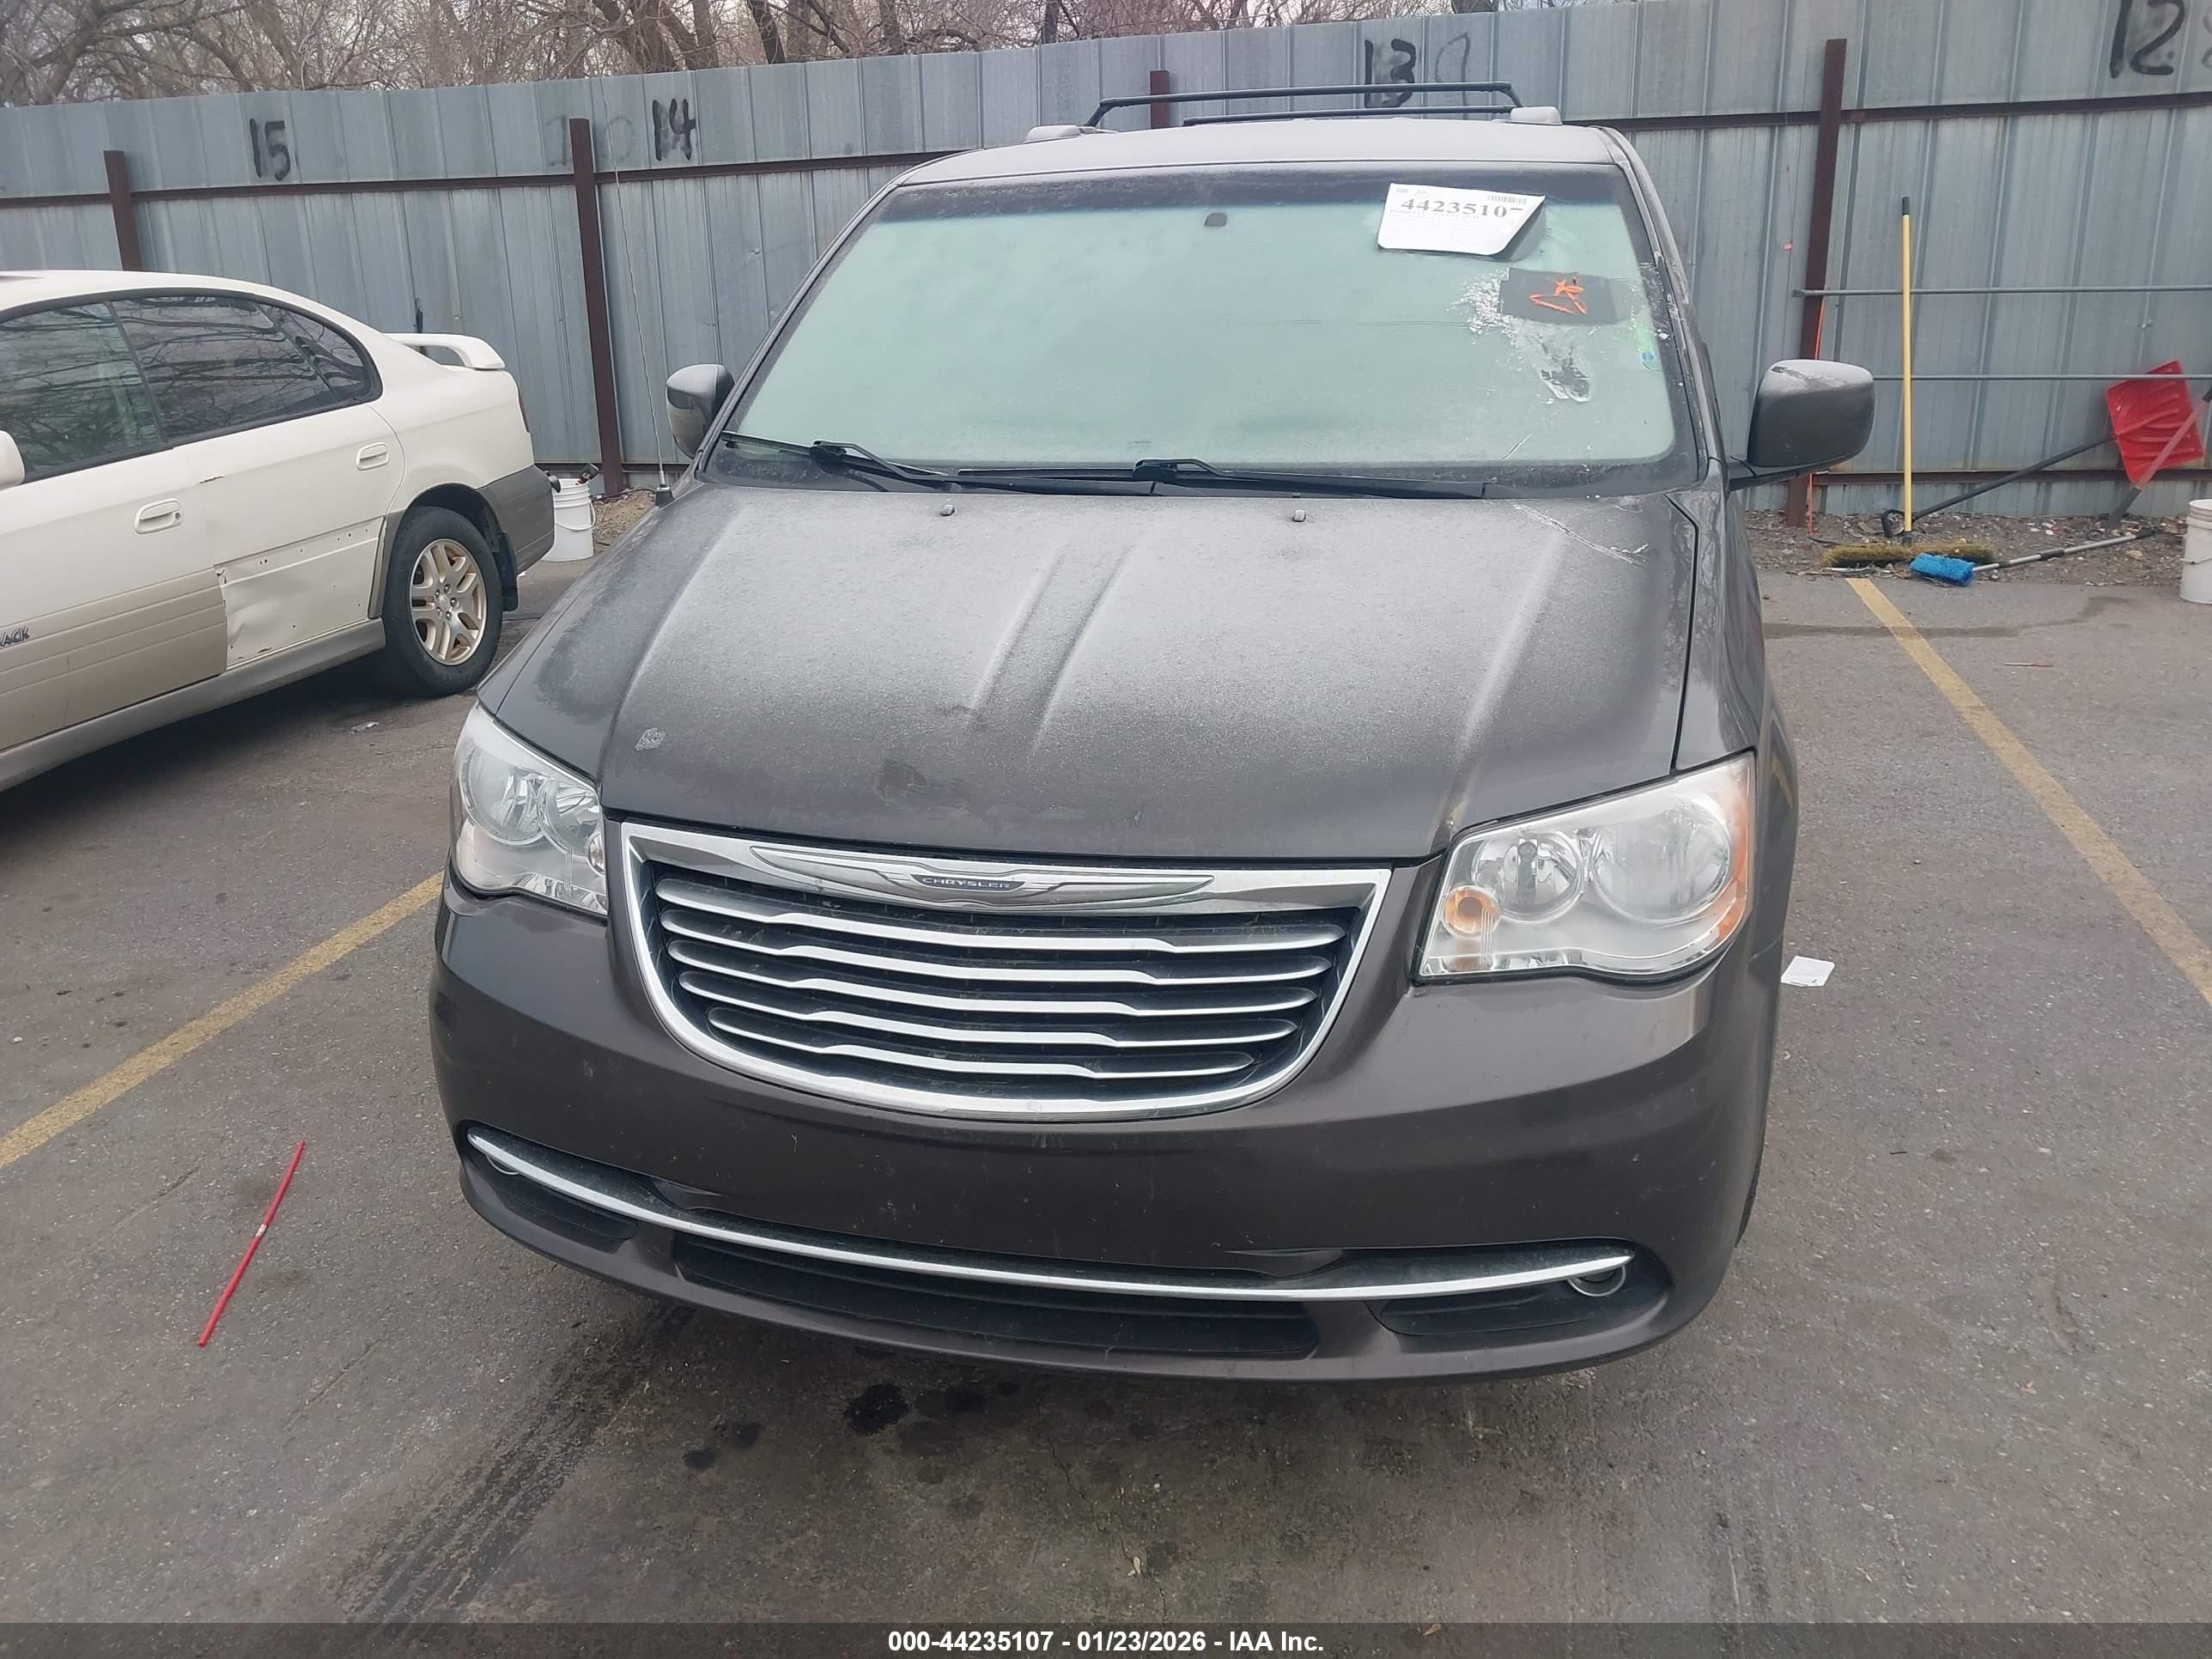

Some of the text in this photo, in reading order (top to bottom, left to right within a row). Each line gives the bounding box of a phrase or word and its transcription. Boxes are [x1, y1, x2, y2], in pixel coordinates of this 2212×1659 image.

[2109, 0, 2185, 78] 12
[1364, 38, 1417, 108] 13
[249, 118, 291, 181] 15
[652, 98, 696, 161] 14
[1401, 198, 1524, 218] 4423510
[921, 877, 1012, 889] CHRYSLER
